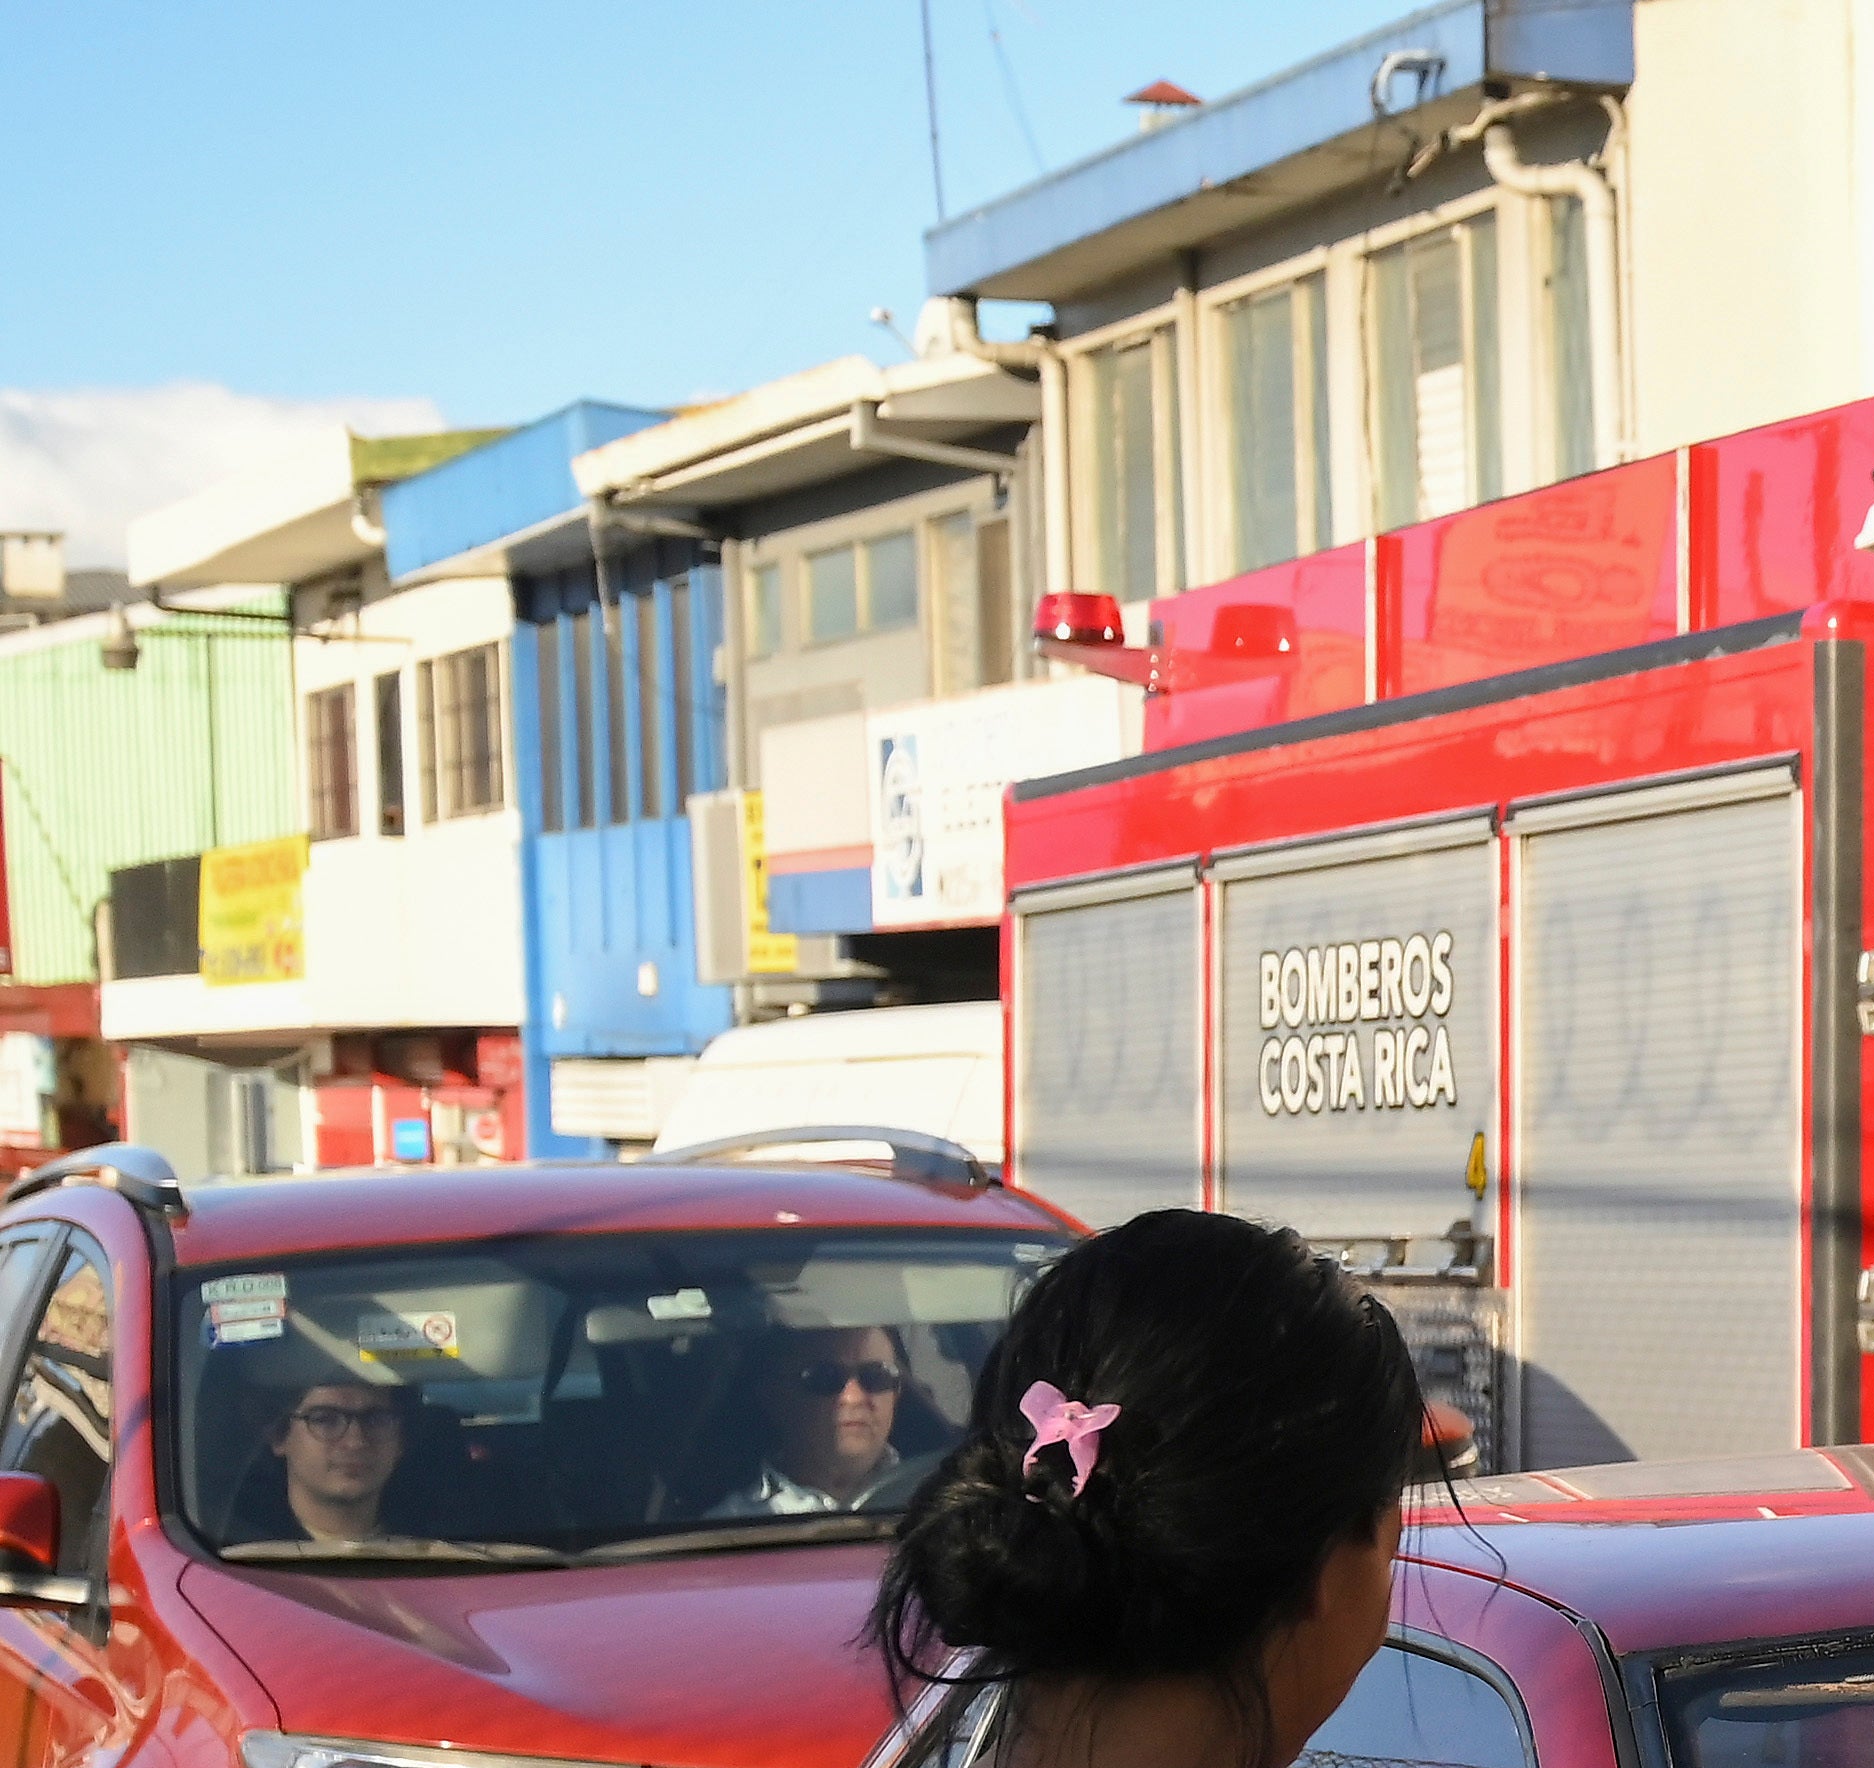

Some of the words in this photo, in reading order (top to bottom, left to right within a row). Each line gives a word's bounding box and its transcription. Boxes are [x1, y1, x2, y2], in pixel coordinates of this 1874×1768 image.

[1260, 930, 1454, 1030] BOMBEROS
[1259, 1030, 1366, 1116] COSTA
[1373, 1024, 1457, 1109] RICA
[1465, 1131, 1488, 1200] 4
